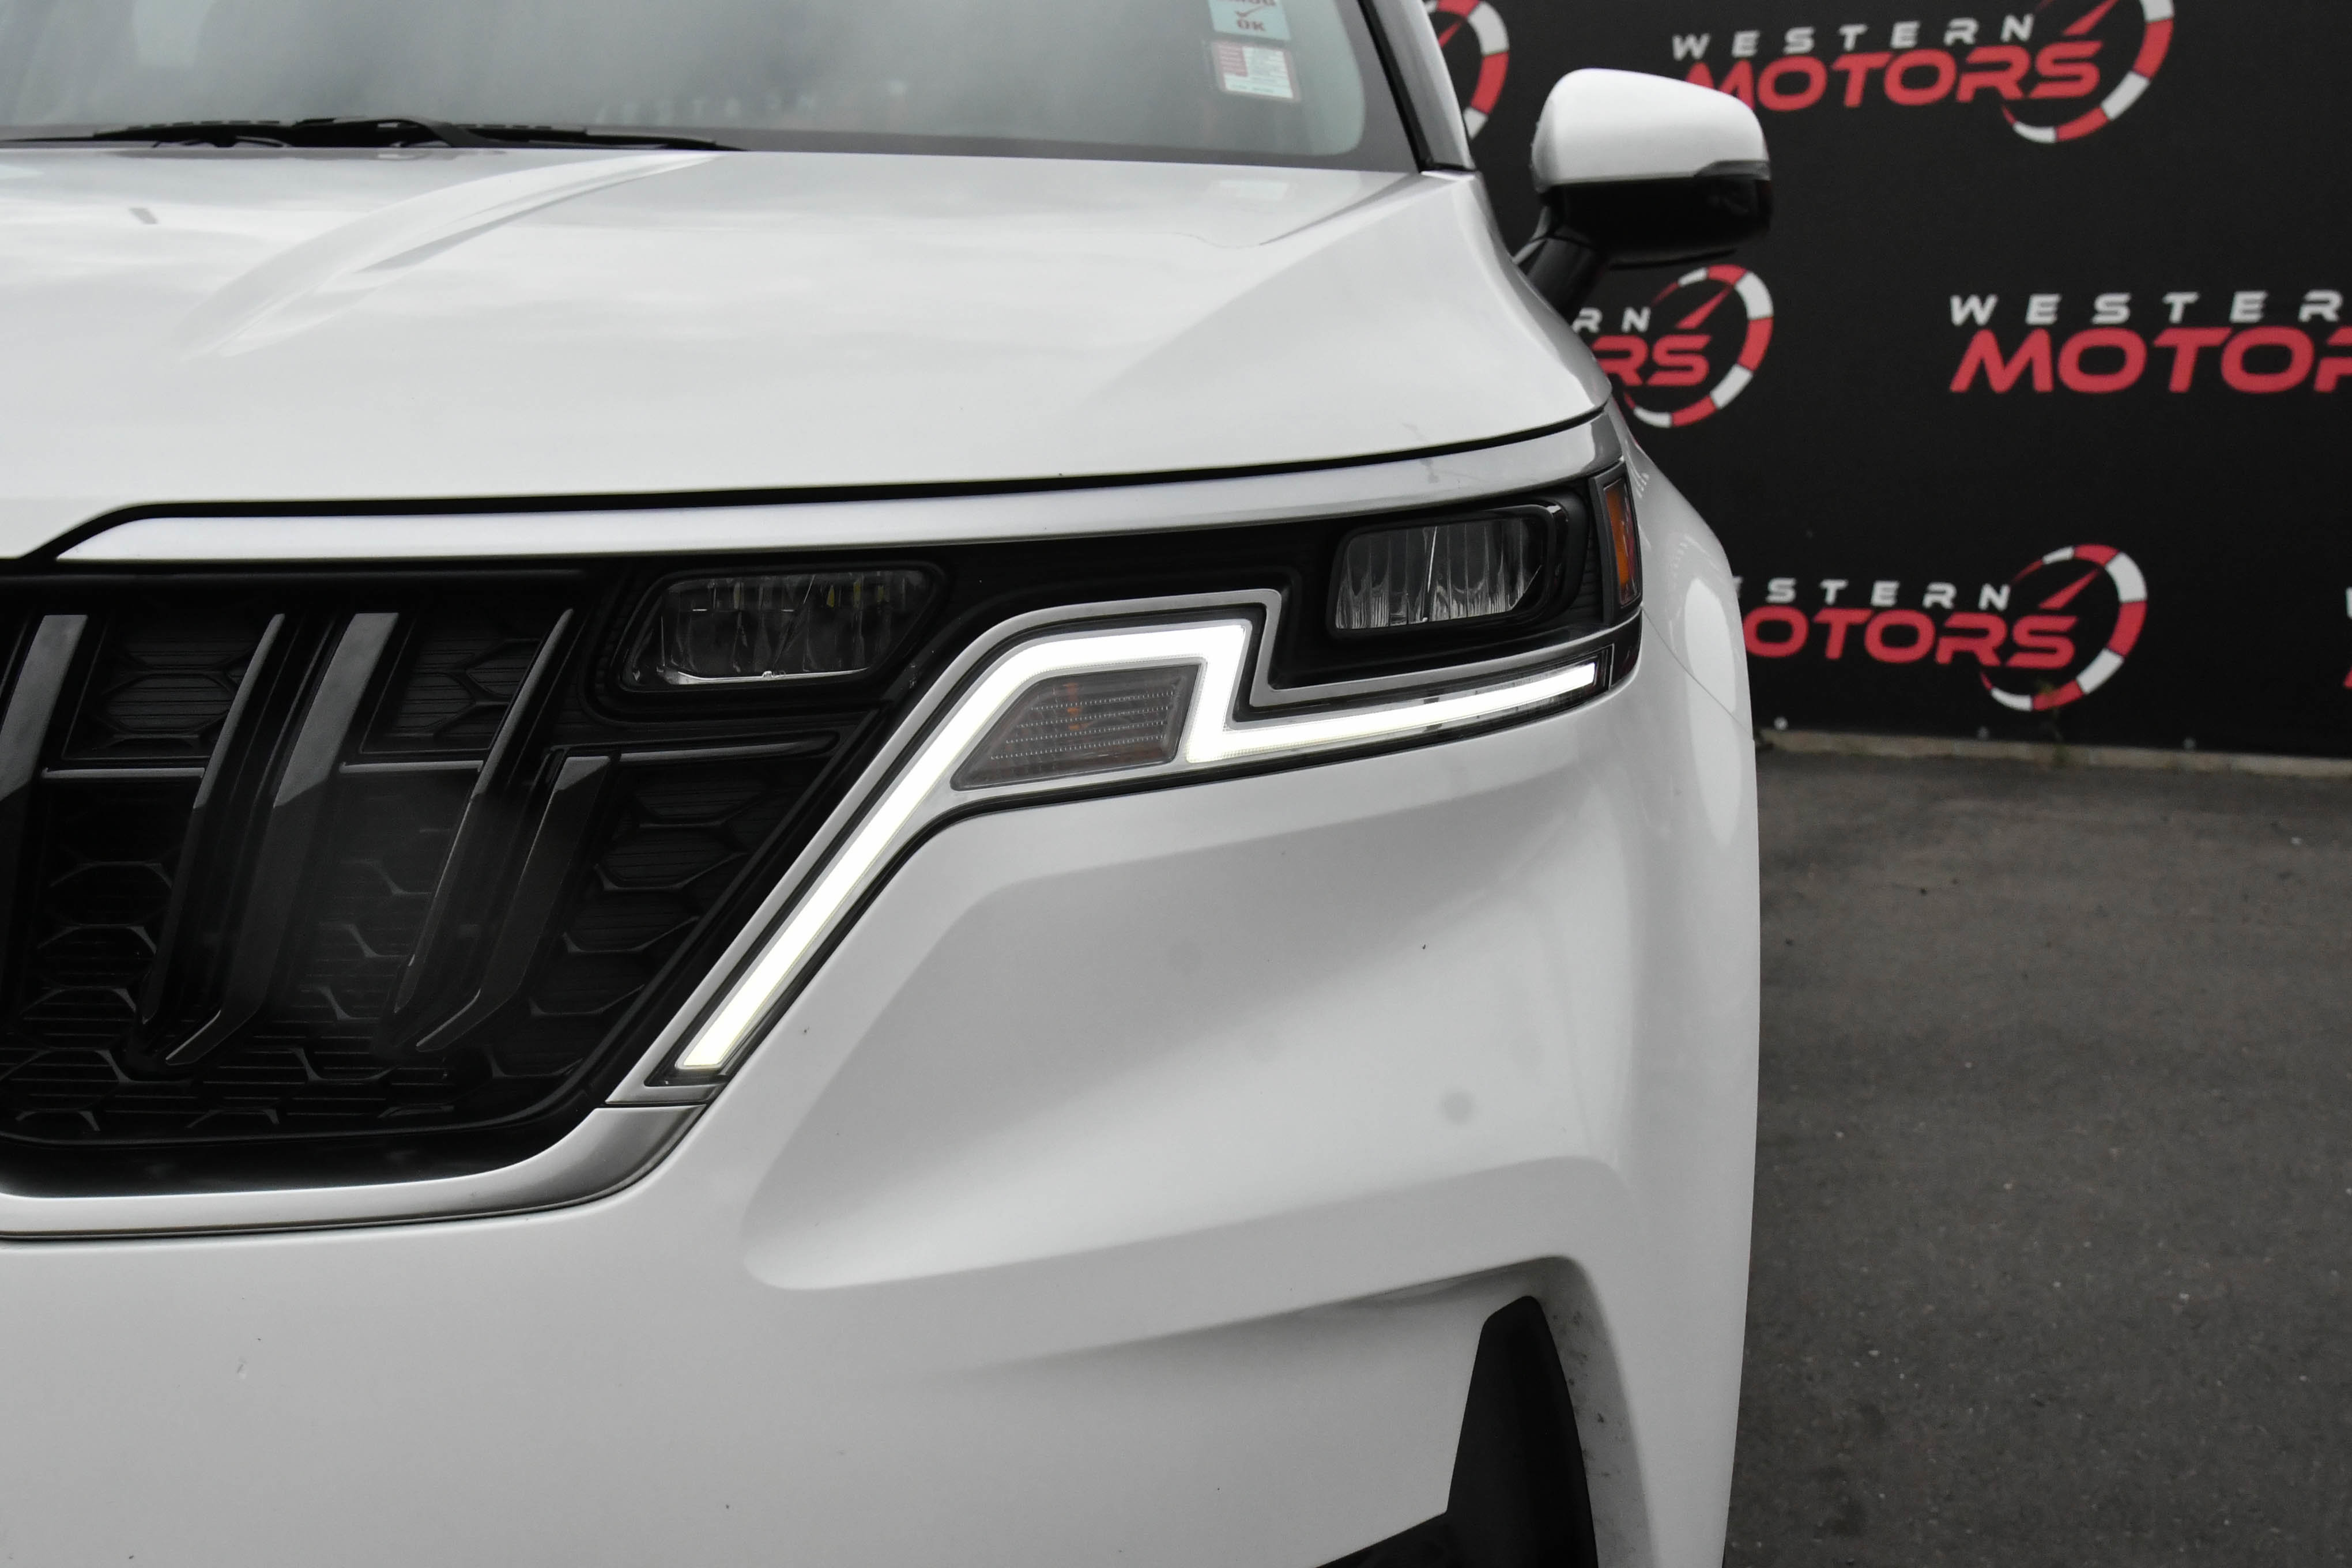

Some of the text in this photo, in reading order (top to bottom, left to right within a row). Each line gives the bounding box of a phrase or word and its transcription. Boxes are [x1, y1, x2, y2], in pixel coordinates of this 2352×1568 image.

[1236, 19, 1265, 31] OK
[1672, 13, 2035, 61] WESTERN
[1950, 289, 2343, 326] WESTER
[1950, 326, 2352, 393] MOTO
[1732, 576, 2011, 611] STERN
[1742, 604, 2077, 669] OTORS
